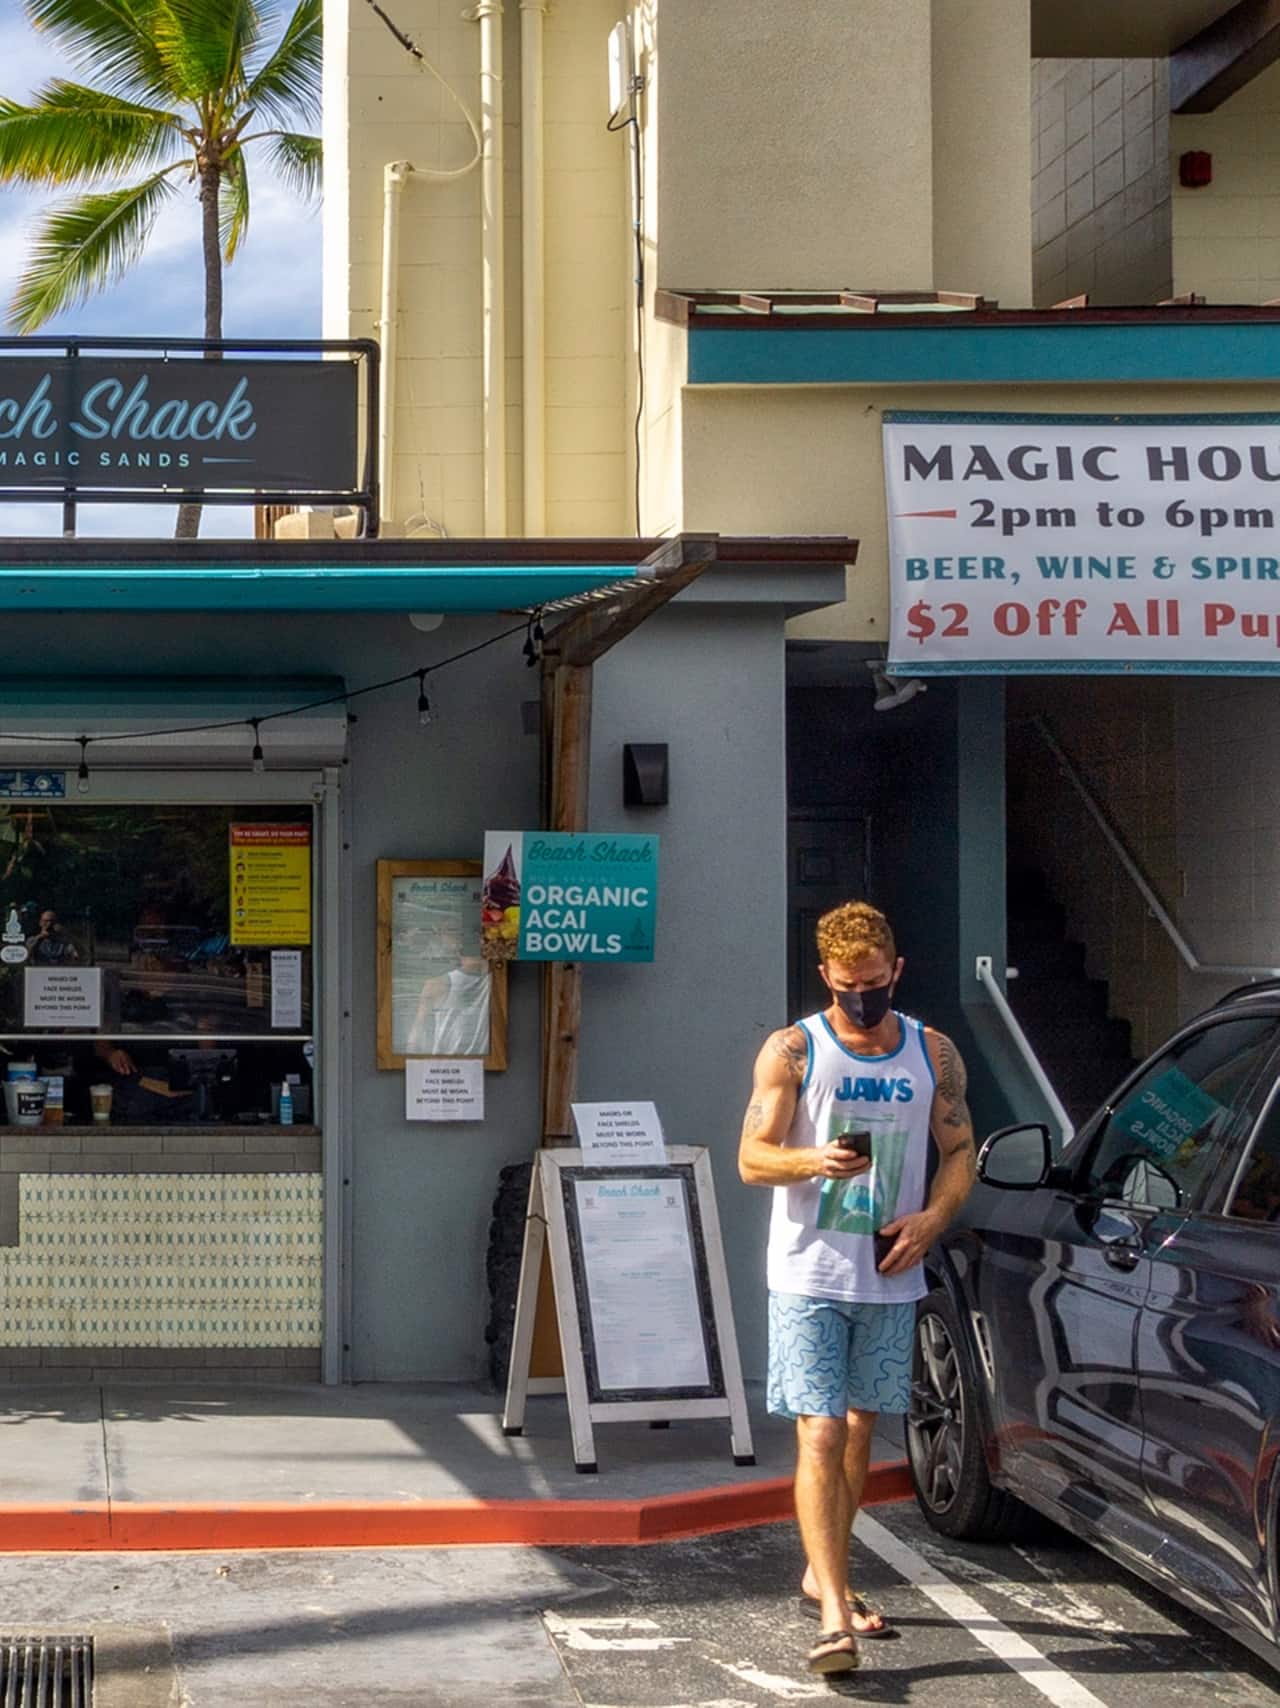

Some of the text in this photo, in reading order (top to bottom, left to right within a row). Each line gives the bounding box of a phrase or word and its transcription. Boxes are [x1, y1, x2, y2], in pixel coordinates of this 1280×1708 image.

[70, 373, 256, 440] Shack
[99, 453, 192, 467] SANDS
[903, 444, 1120, 482] MAGIC
[969, 498, 1274, 537] 2pm to 6pm
[905, 555, 1280, 585] BEER, WINE & SPIR
[906, 598, 1280, 648] $2 Off All Pu
[527, 839, 653, 863] Beach Shack
[527, 885, 649, 907] ORGANIC
[526, 909, 587, 929] ACAI
[526, 932, 622, 954] BOWLS
[835, 1076, 915, 1103] JAWS
